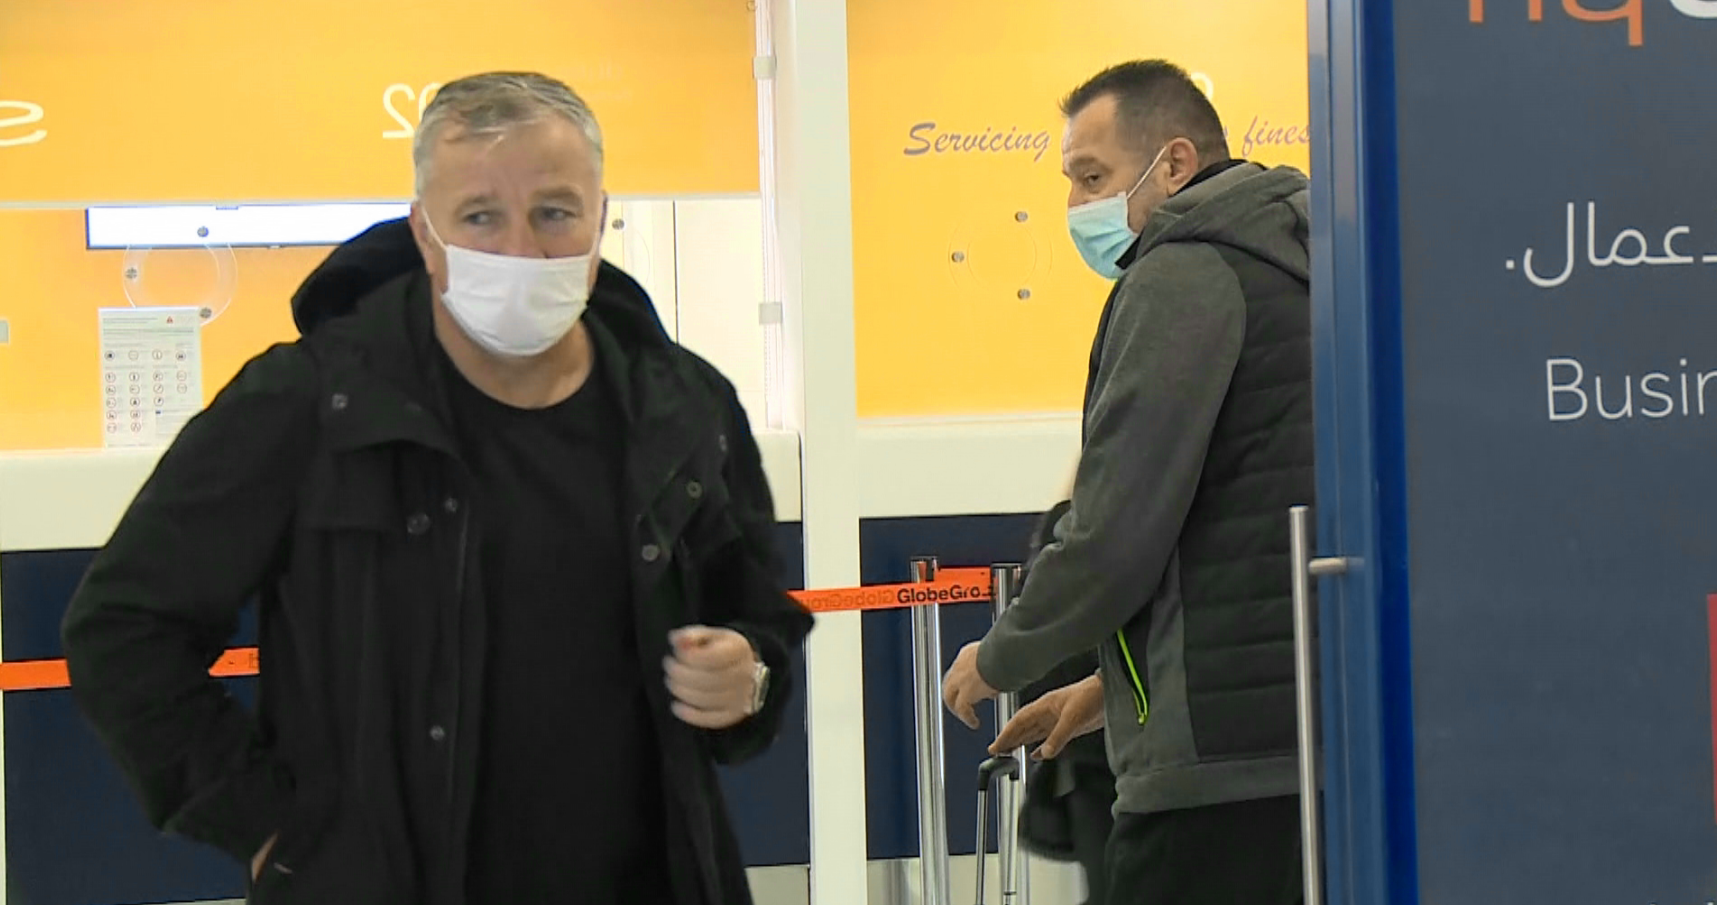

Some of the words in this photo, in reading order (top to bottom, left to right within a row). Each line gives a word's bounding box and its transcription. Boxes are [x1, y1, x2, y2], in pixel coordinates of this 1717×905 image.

[903, 122, 1050, 162] Servicing
[1506, 201, 1717, 287] عمال.
[897, 584, 994, 604] GlobeGro
